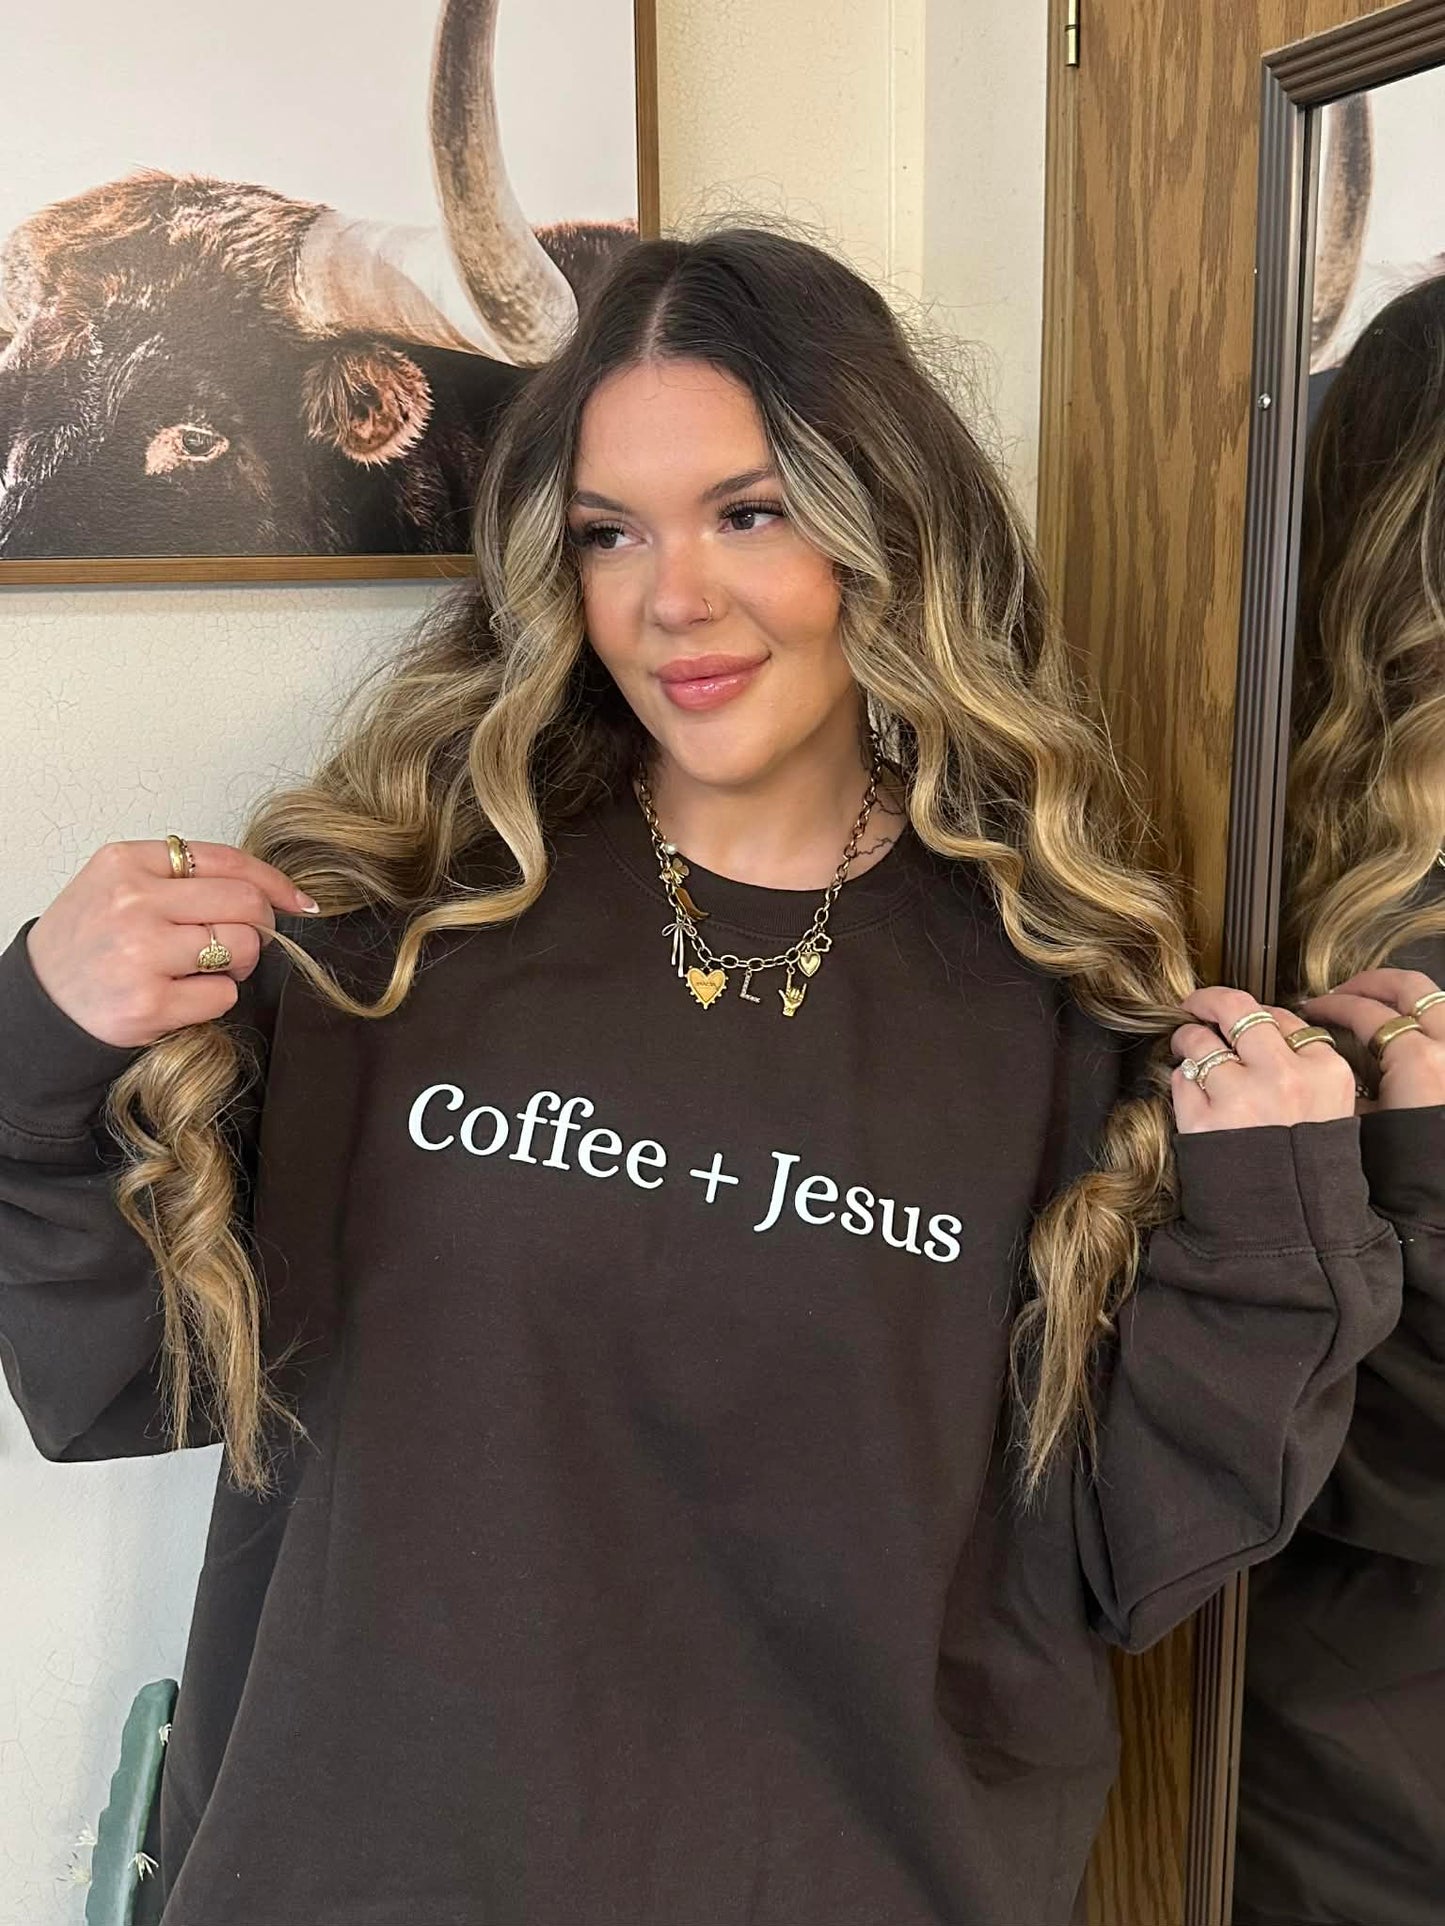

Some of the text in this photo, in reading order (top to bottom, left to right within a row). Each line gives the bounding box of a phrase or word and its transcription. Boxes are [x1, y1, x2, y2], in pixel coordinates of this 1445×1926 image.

[740, 973, 761, 1003] L
[408, 1083, 962, 1263] Coffee + Jesus
